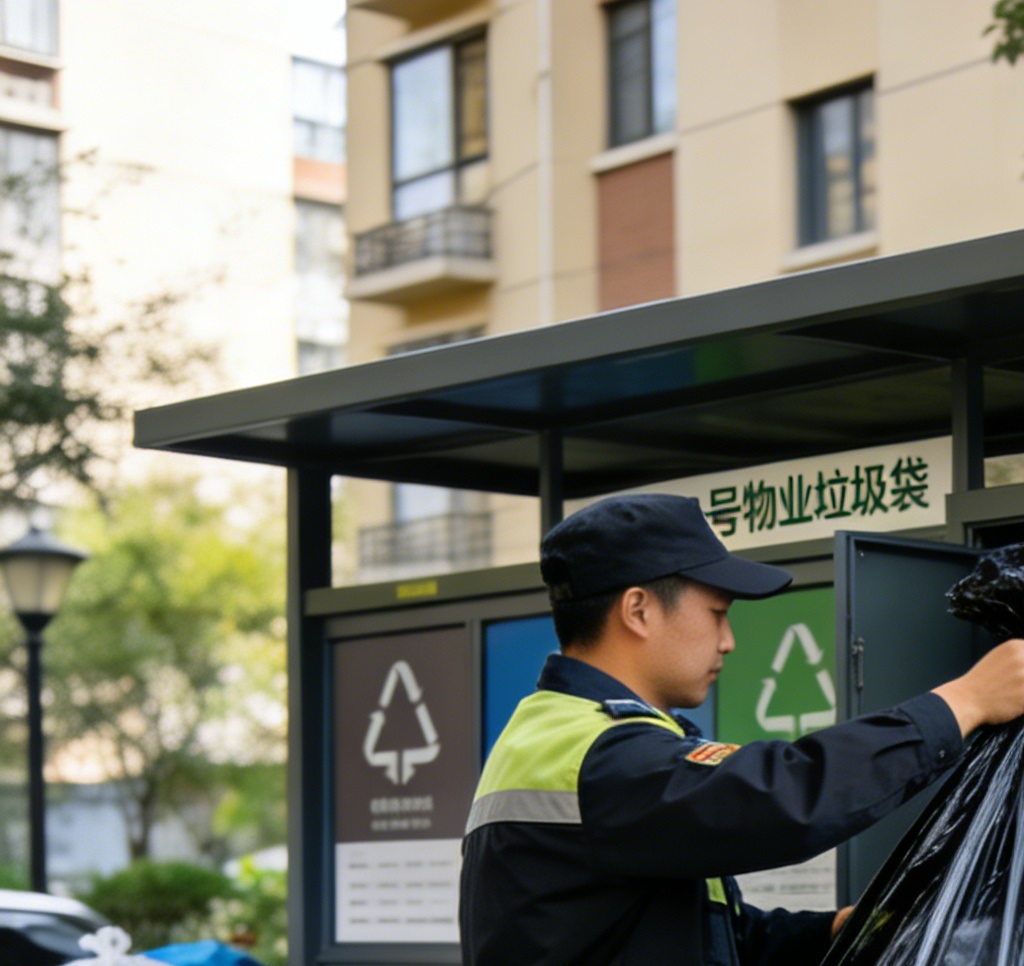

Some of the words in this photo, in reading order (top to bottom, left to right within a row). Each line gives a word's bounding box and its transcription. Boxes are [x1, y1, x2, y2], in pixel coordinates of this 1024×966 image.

[706, 456, 930, 537] 号物业垃圾袋
